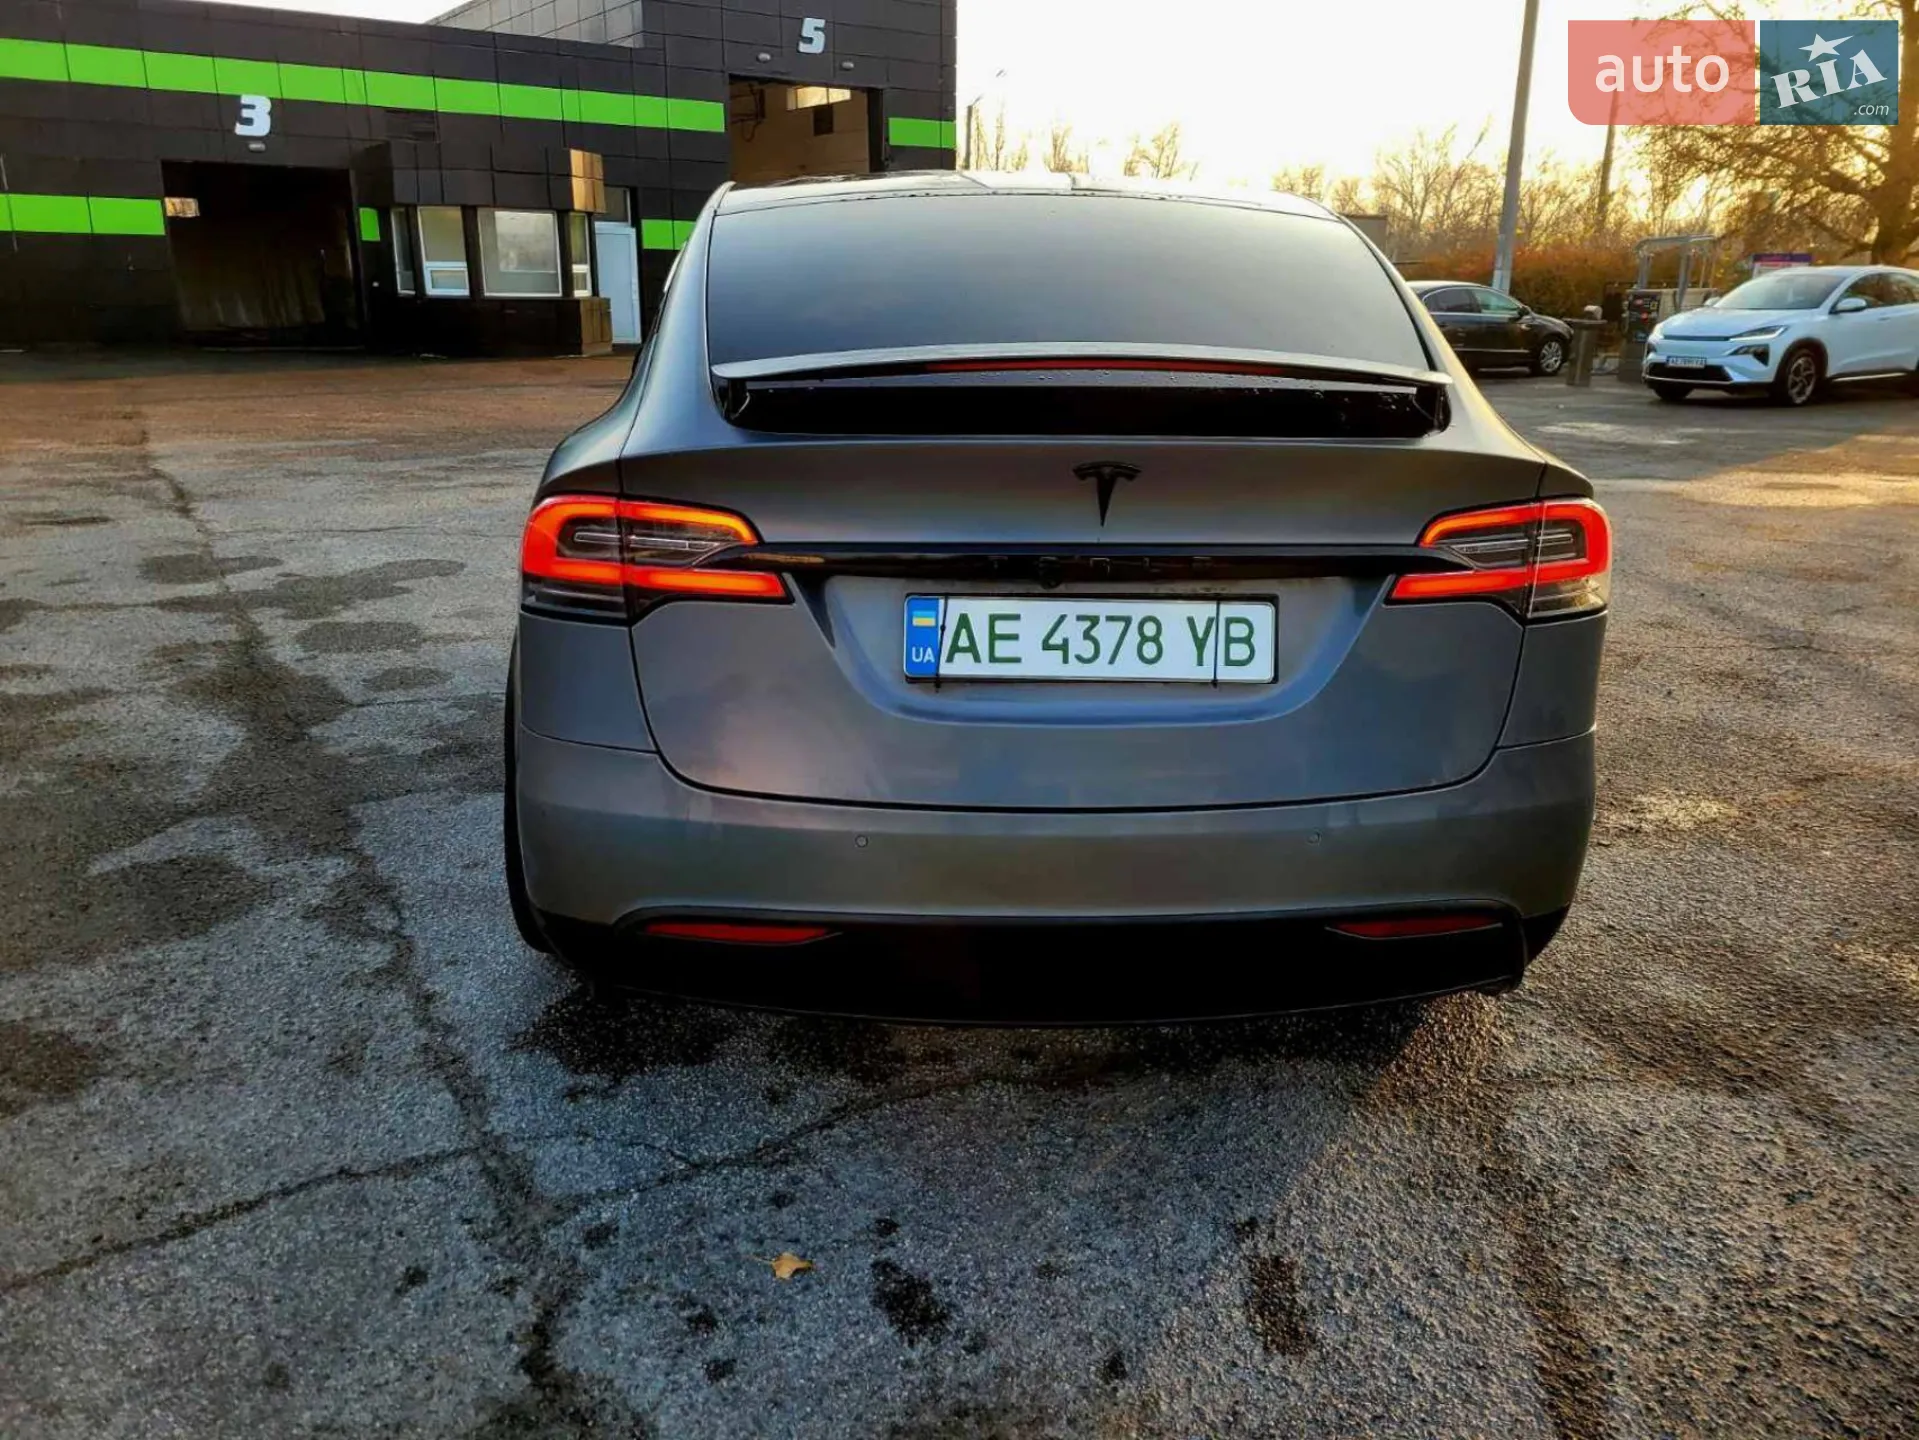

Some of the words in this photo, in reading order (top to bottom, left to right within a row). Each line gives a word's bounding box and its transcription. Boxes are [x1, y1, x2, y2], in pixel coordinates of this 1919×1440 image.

[798, 17, 826, 54] 5
[234, 94, 272, 137] 3
[911, 646, 936, 664] UA
[944, 612, 1022, 665] AE
[1041, 613, 1164, 666] 4378
[1186, 615, 1257, 667] YB
